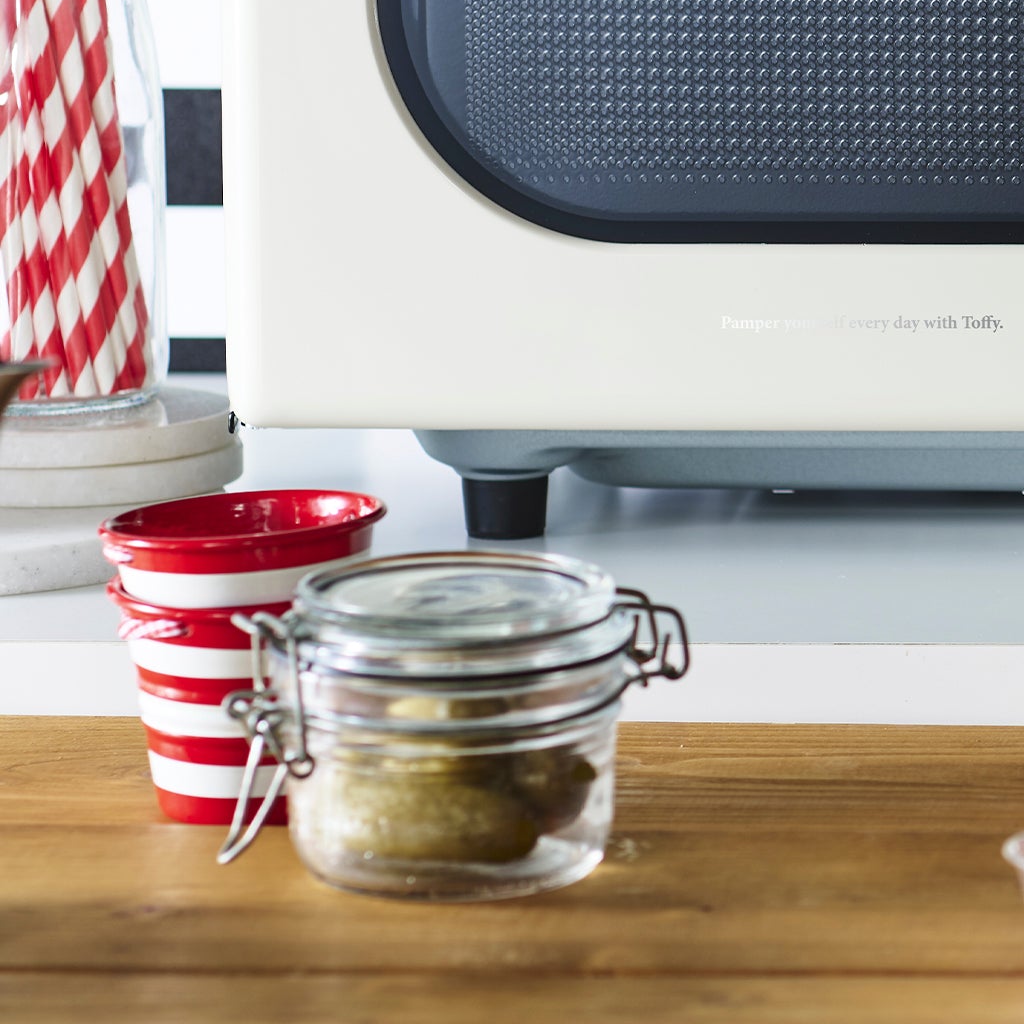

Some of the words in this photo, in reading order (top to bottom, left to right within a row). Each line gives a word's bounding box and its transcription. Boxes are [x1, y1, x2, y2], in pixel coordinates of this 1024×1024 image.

[720, 315, 779, 333] Pamper
[849, 319, 890, 333] every
[893, 315, 920, 333] day
[923, 315, 958, 329] with
[961, 315, 1004, 333] Toffy.
